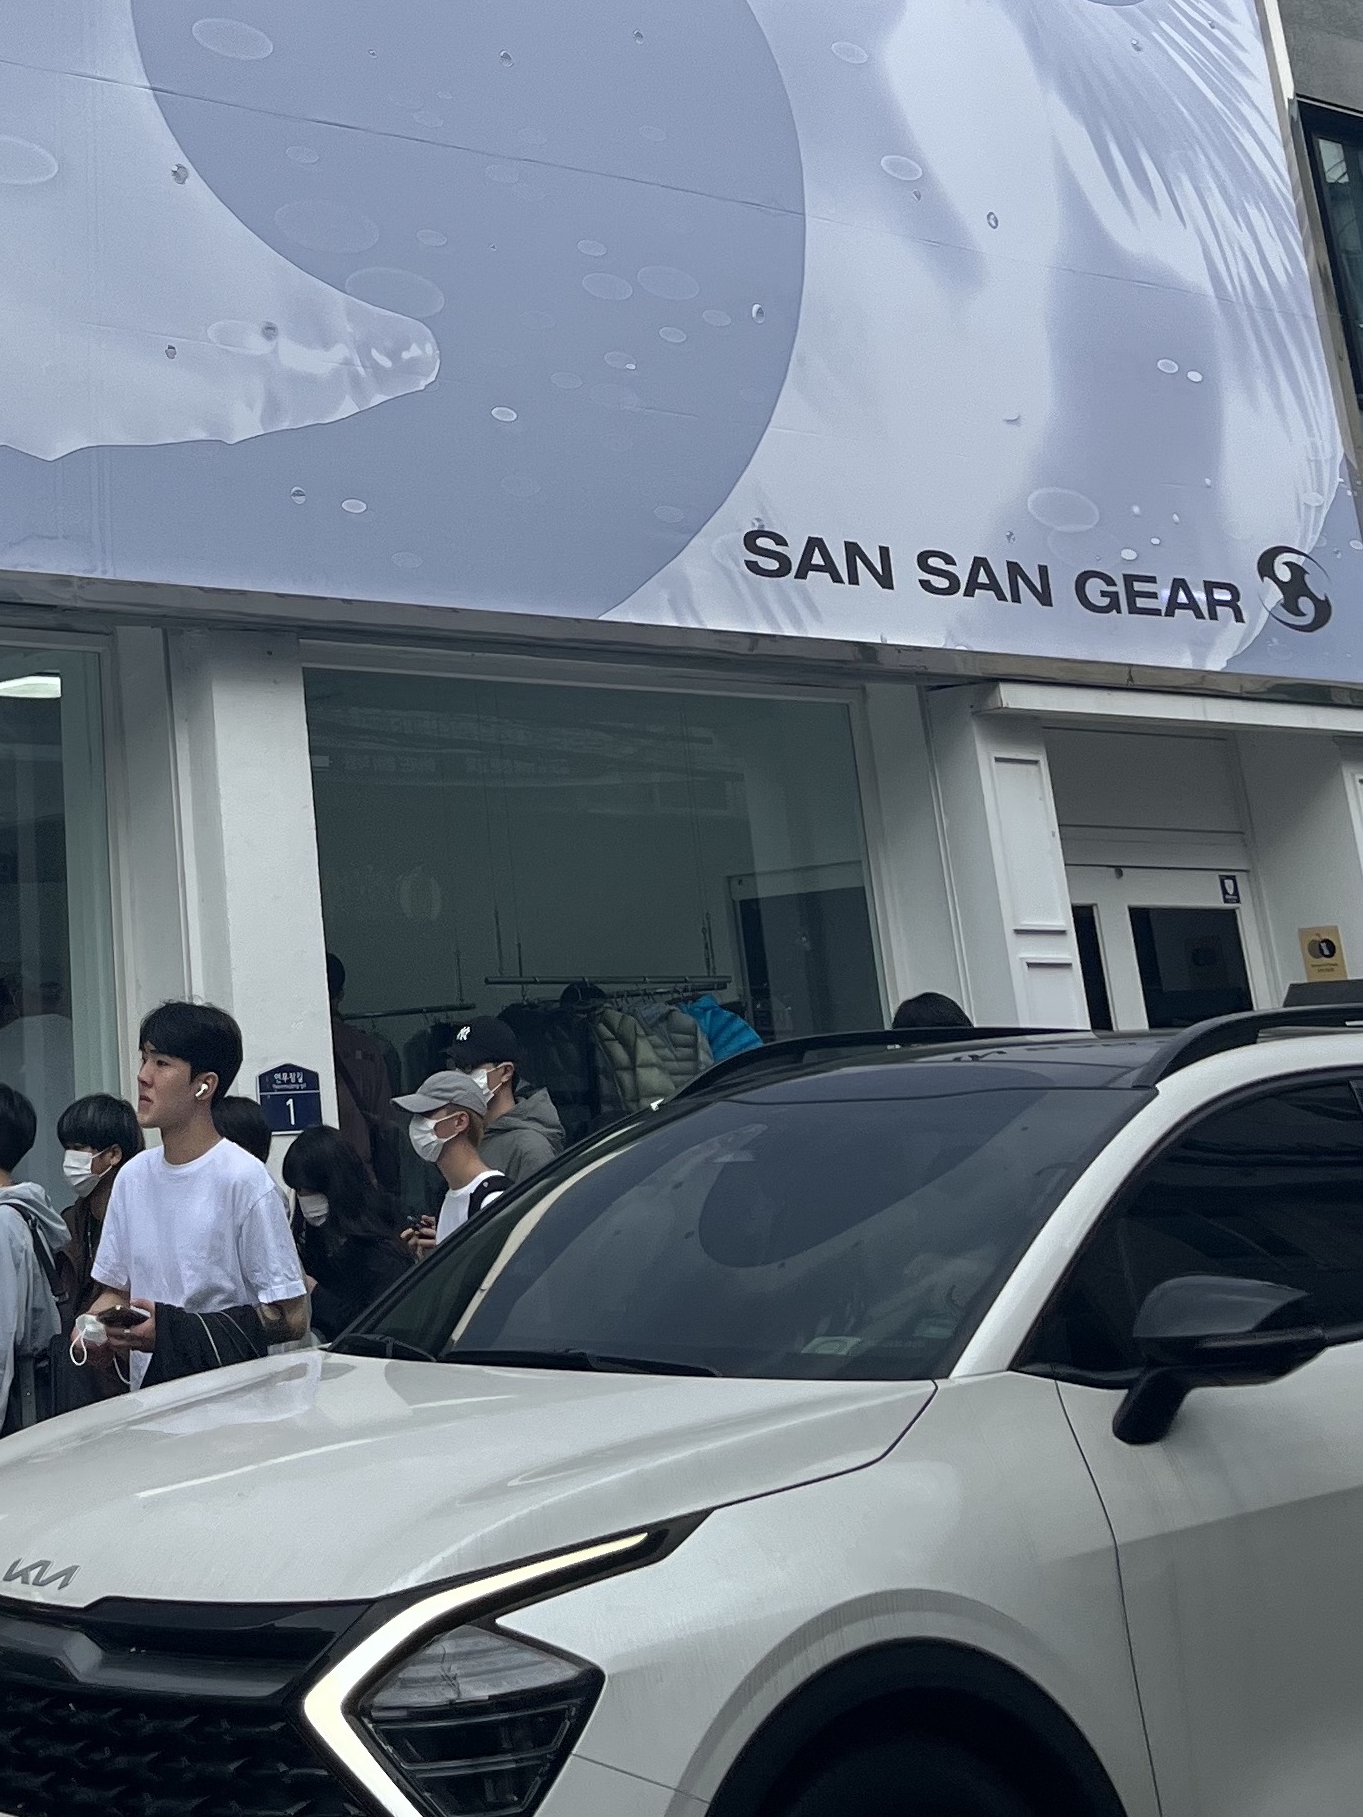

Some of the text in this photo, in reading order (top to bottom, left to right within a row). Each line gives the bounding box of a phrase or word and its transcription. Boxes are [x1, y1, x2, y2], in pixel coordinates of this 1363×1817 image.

[742, 529, 1246, 623] SAN SAN GEAR
[286, 1098, 295, 1125] 1
